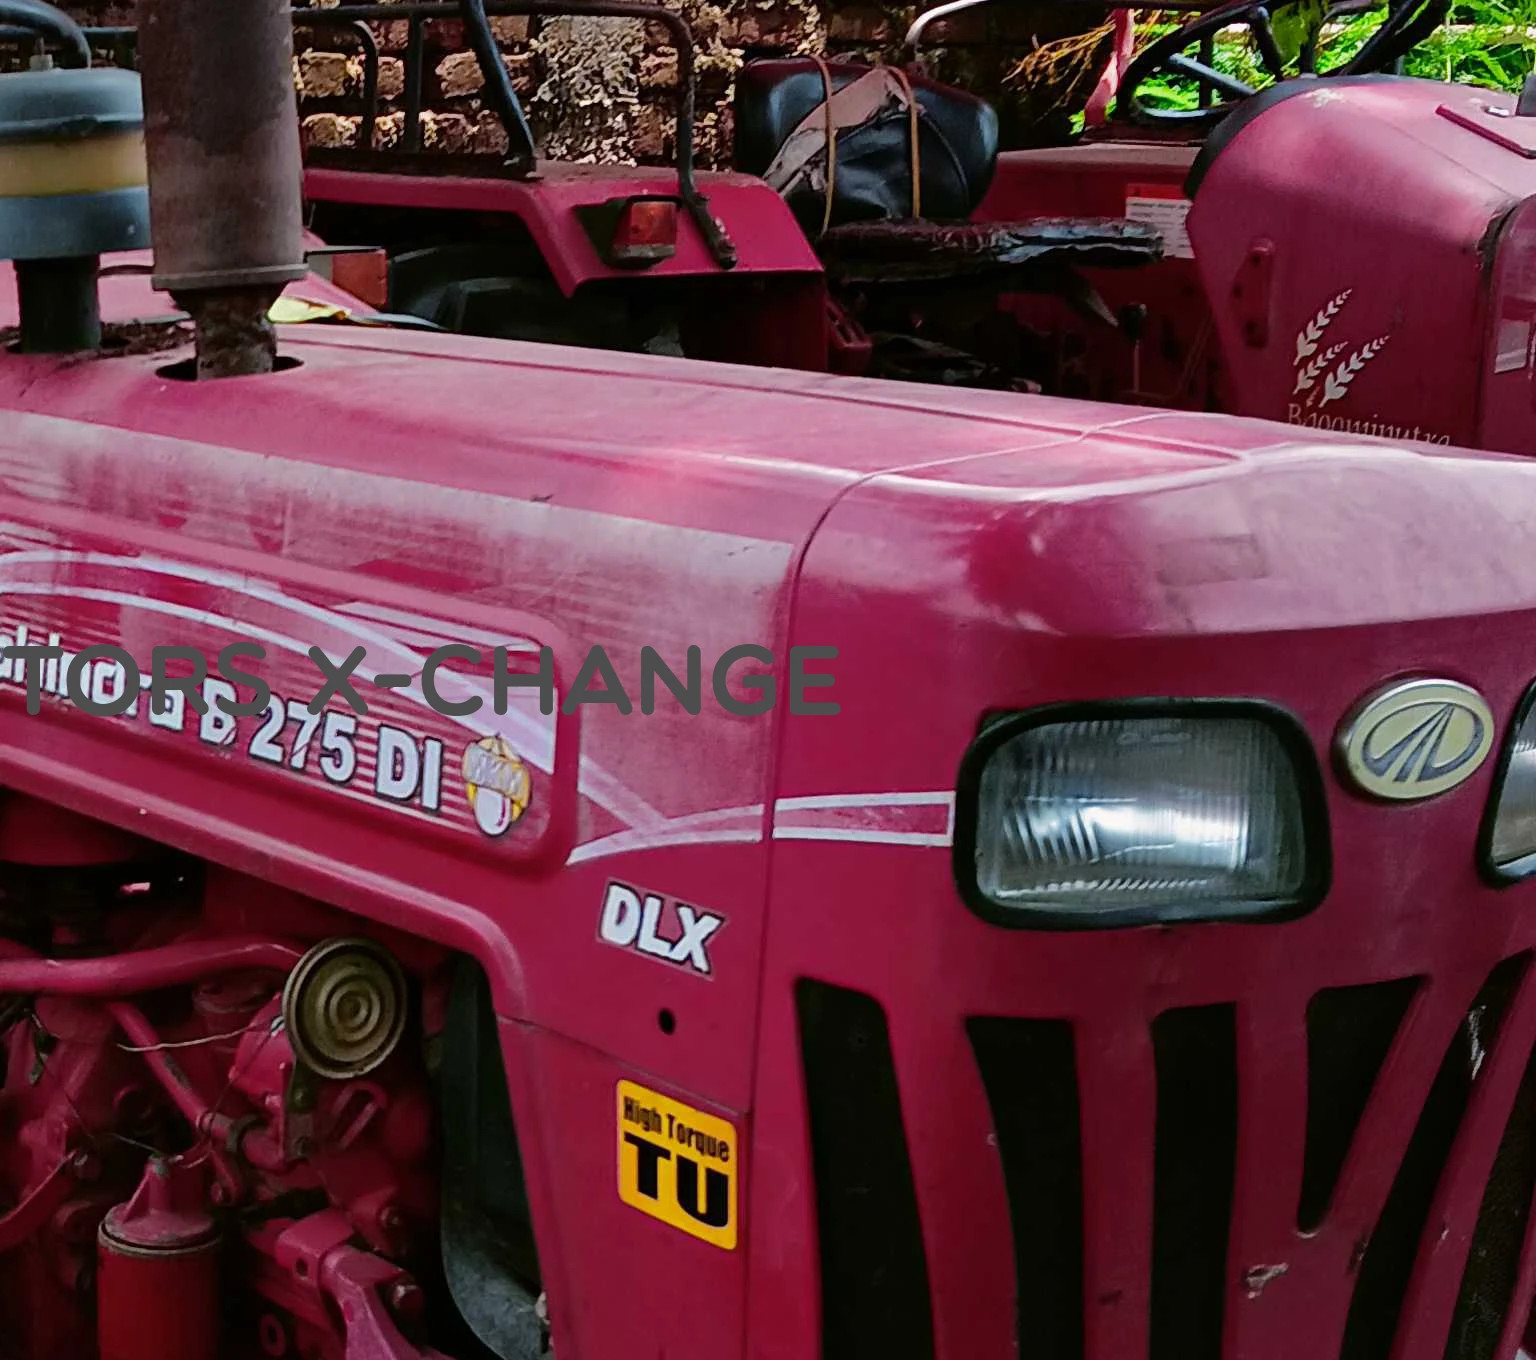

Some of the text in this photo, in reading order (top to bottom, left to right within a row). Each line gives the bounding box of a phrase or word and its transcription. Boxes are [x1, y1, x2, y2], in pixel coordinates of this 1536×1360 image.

[249, 691, 357, 784] 275
[375, 723, 444, 813] DI
[600, 881, 725, 975] DLX
[624, 1095, 729, 1162] High Torque
[624, 1131, 729, 1227] TU
